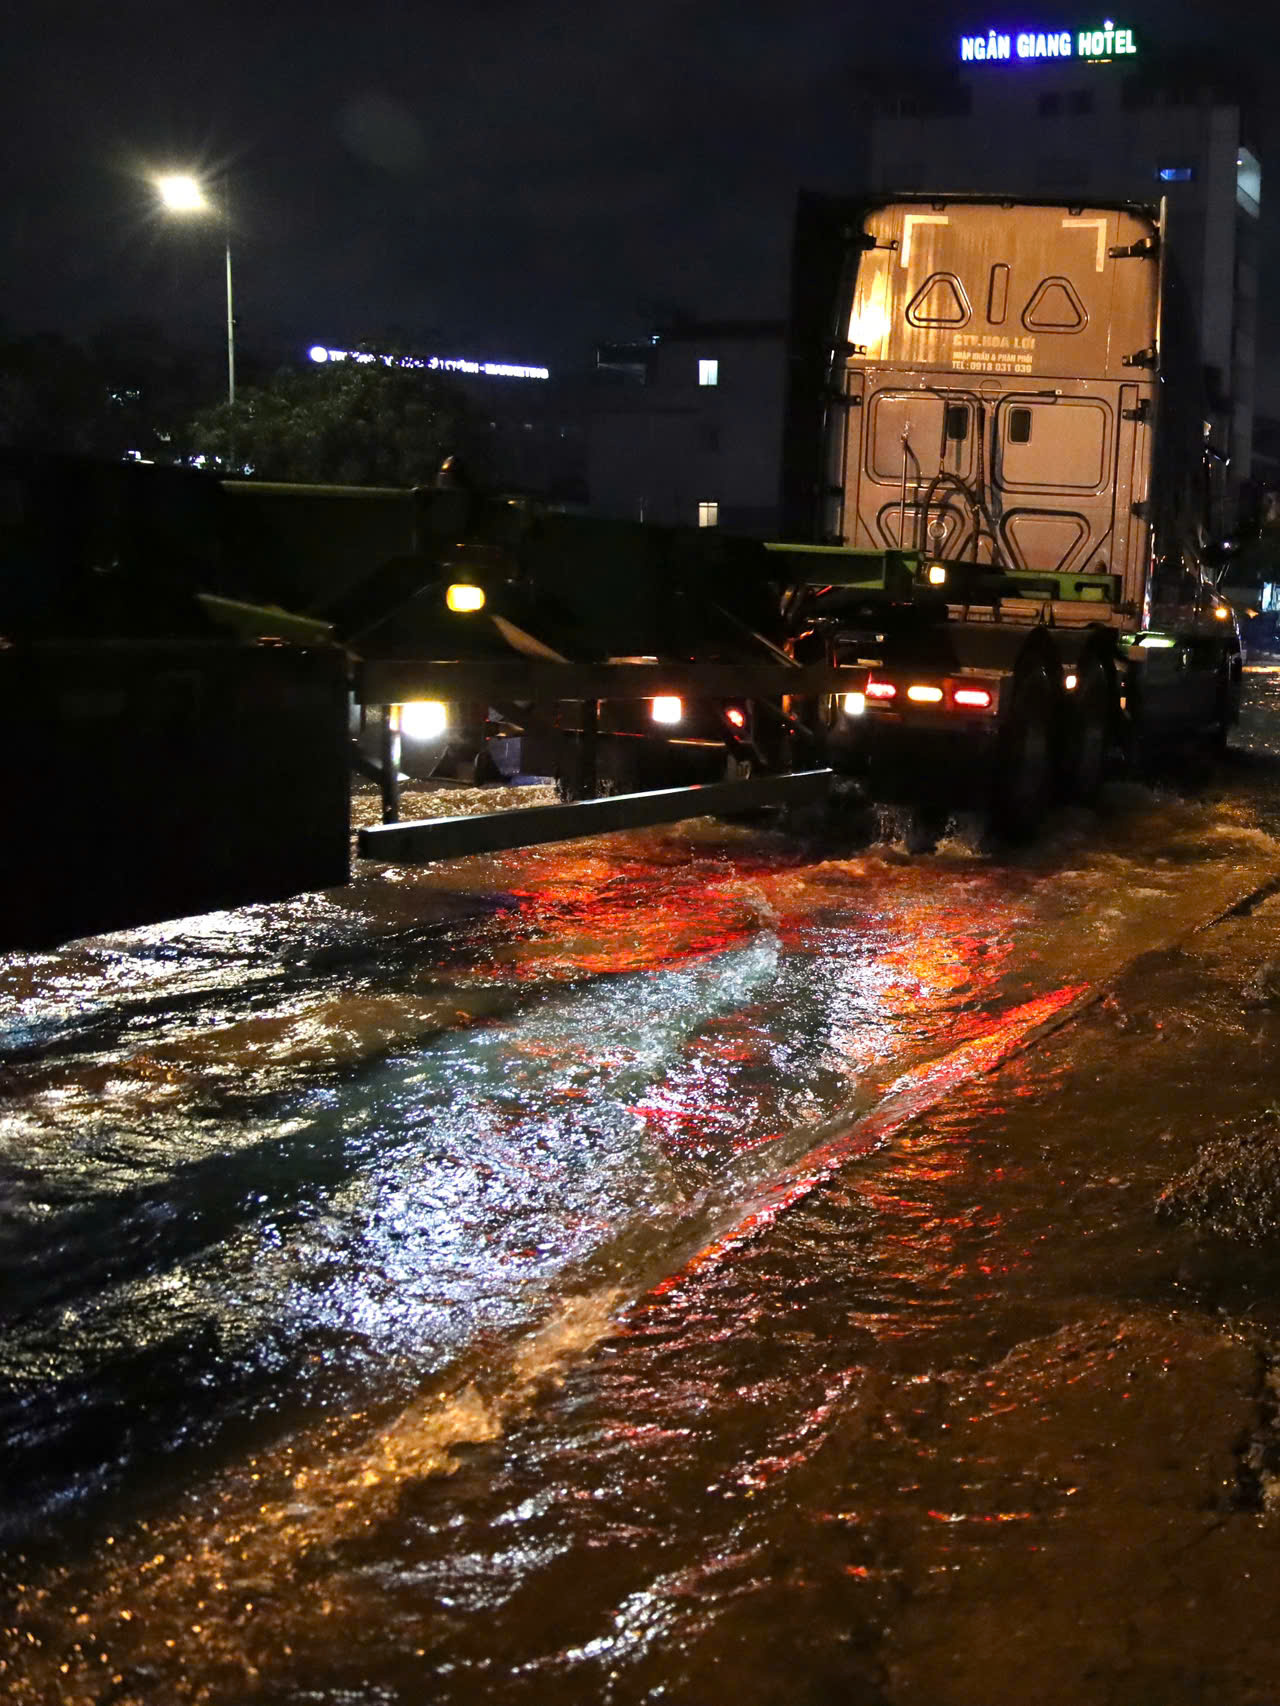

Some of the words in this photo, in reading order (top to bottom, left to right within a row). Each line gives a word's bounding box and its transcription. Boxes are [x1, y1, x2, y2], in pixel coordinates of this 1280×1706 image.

[961, 30, 1011, 60] NGÂN
[1016, 32, 1072, 58] GIANG
[1078, 29, 1137, 56] HOTEL
[995, 362, 1011, 372] 031
